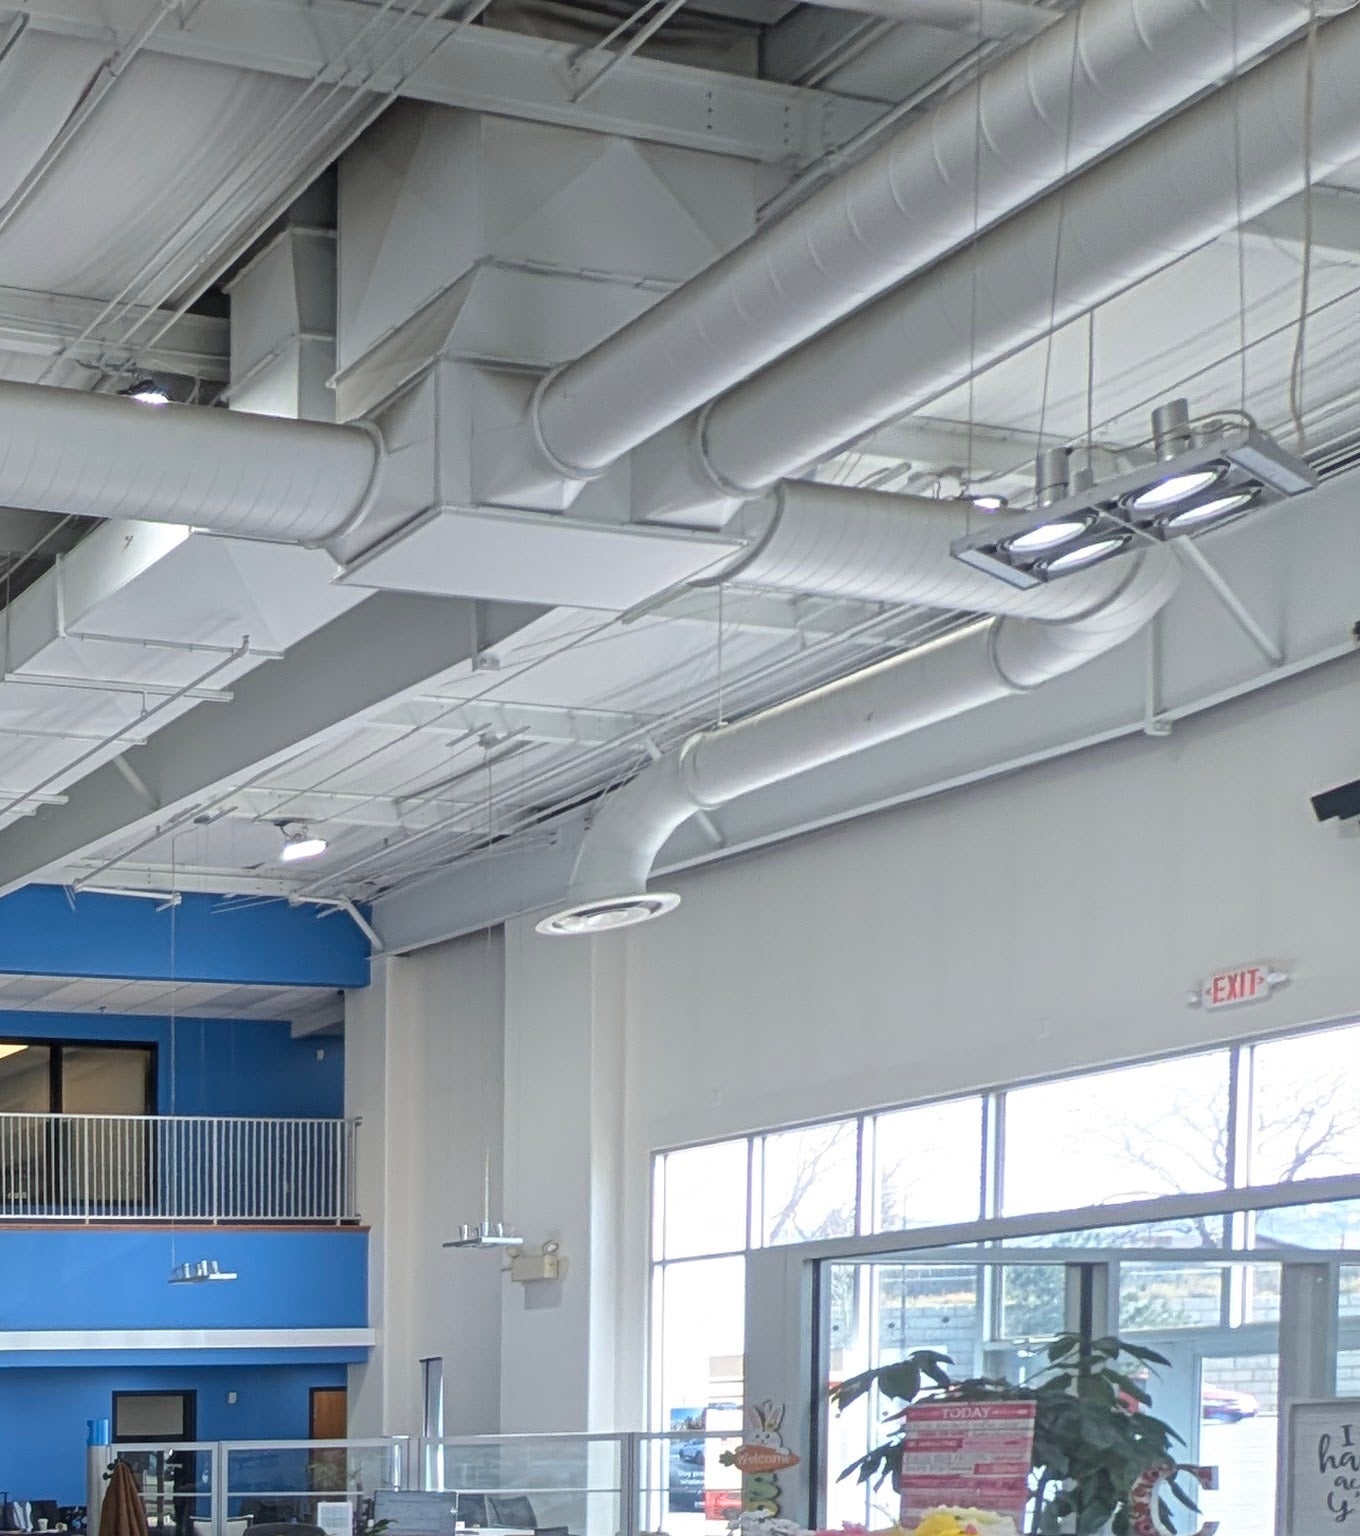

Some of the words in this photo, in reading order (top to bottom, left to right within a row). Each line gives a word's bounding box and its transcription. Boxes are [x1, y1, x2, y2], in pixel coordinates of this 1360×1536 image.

[1212, 968, 1260, 1005] EXIT
[942, 1406, 991, 1419] TODAY
[1340, 1424, 1355, 1448] I
[739, 1452, 791, 1466] Welcome
